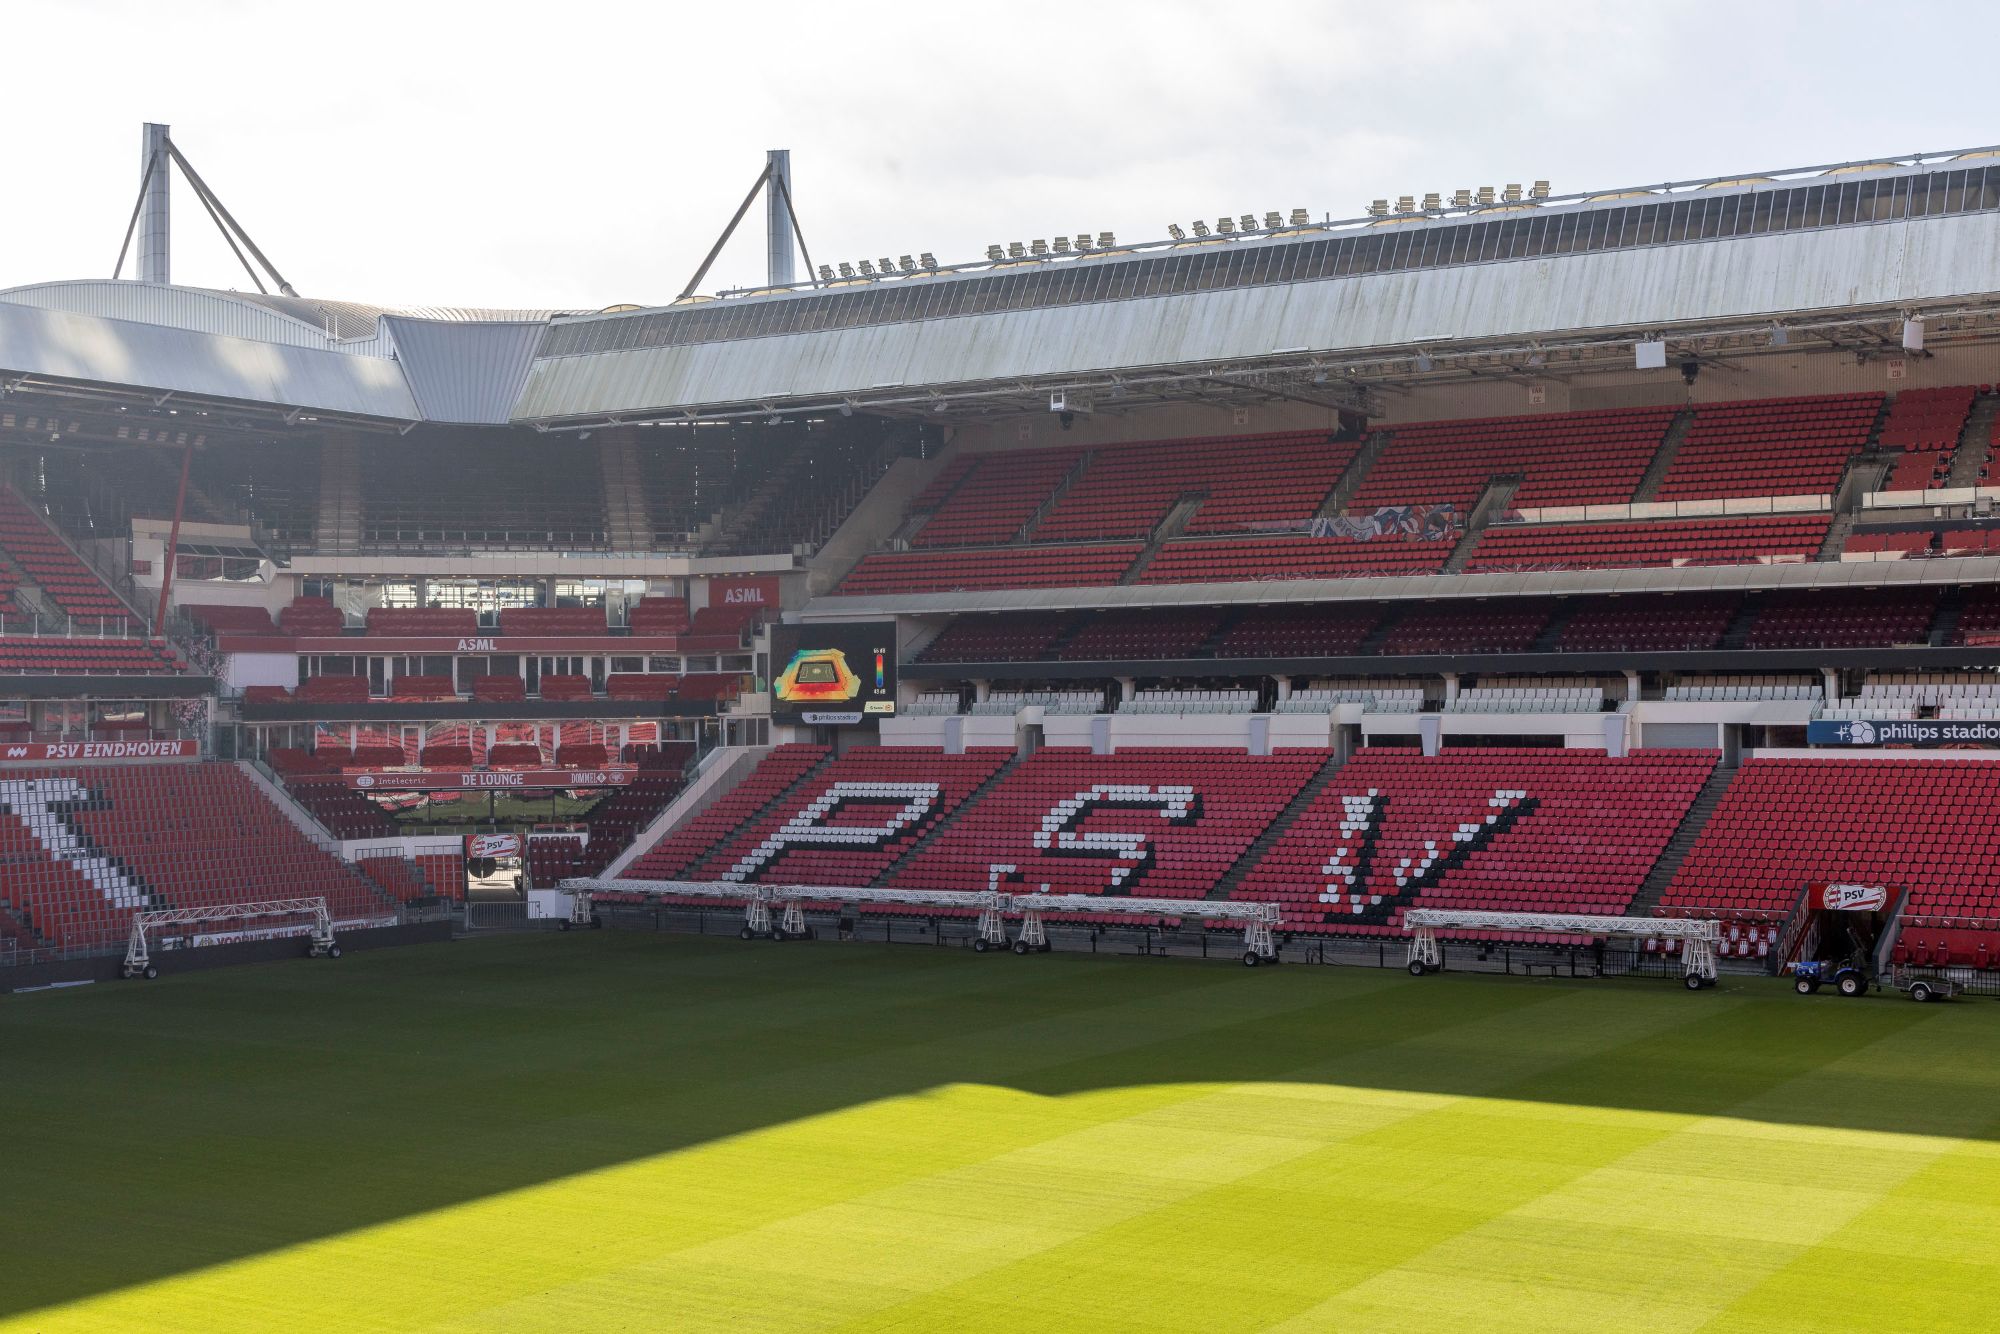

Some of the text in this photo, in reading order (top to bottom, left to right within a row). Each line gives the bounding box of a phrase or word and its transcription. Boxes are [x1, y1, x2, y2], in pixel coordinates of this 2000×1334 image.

[724, 587, 765, 603] ASML
[457, 638, 498, 651] ASML
[1880, 723, 1938, 741] philips
[46, 741, 182, 759] PSV EINDHOVEN
[378, 777, 427, 785] Intelectric
[461, 773, 524, 785] DE LOUNGE
[486, 840, 504, 850] PSV
[1844, 889, 1865, 901] PSV
